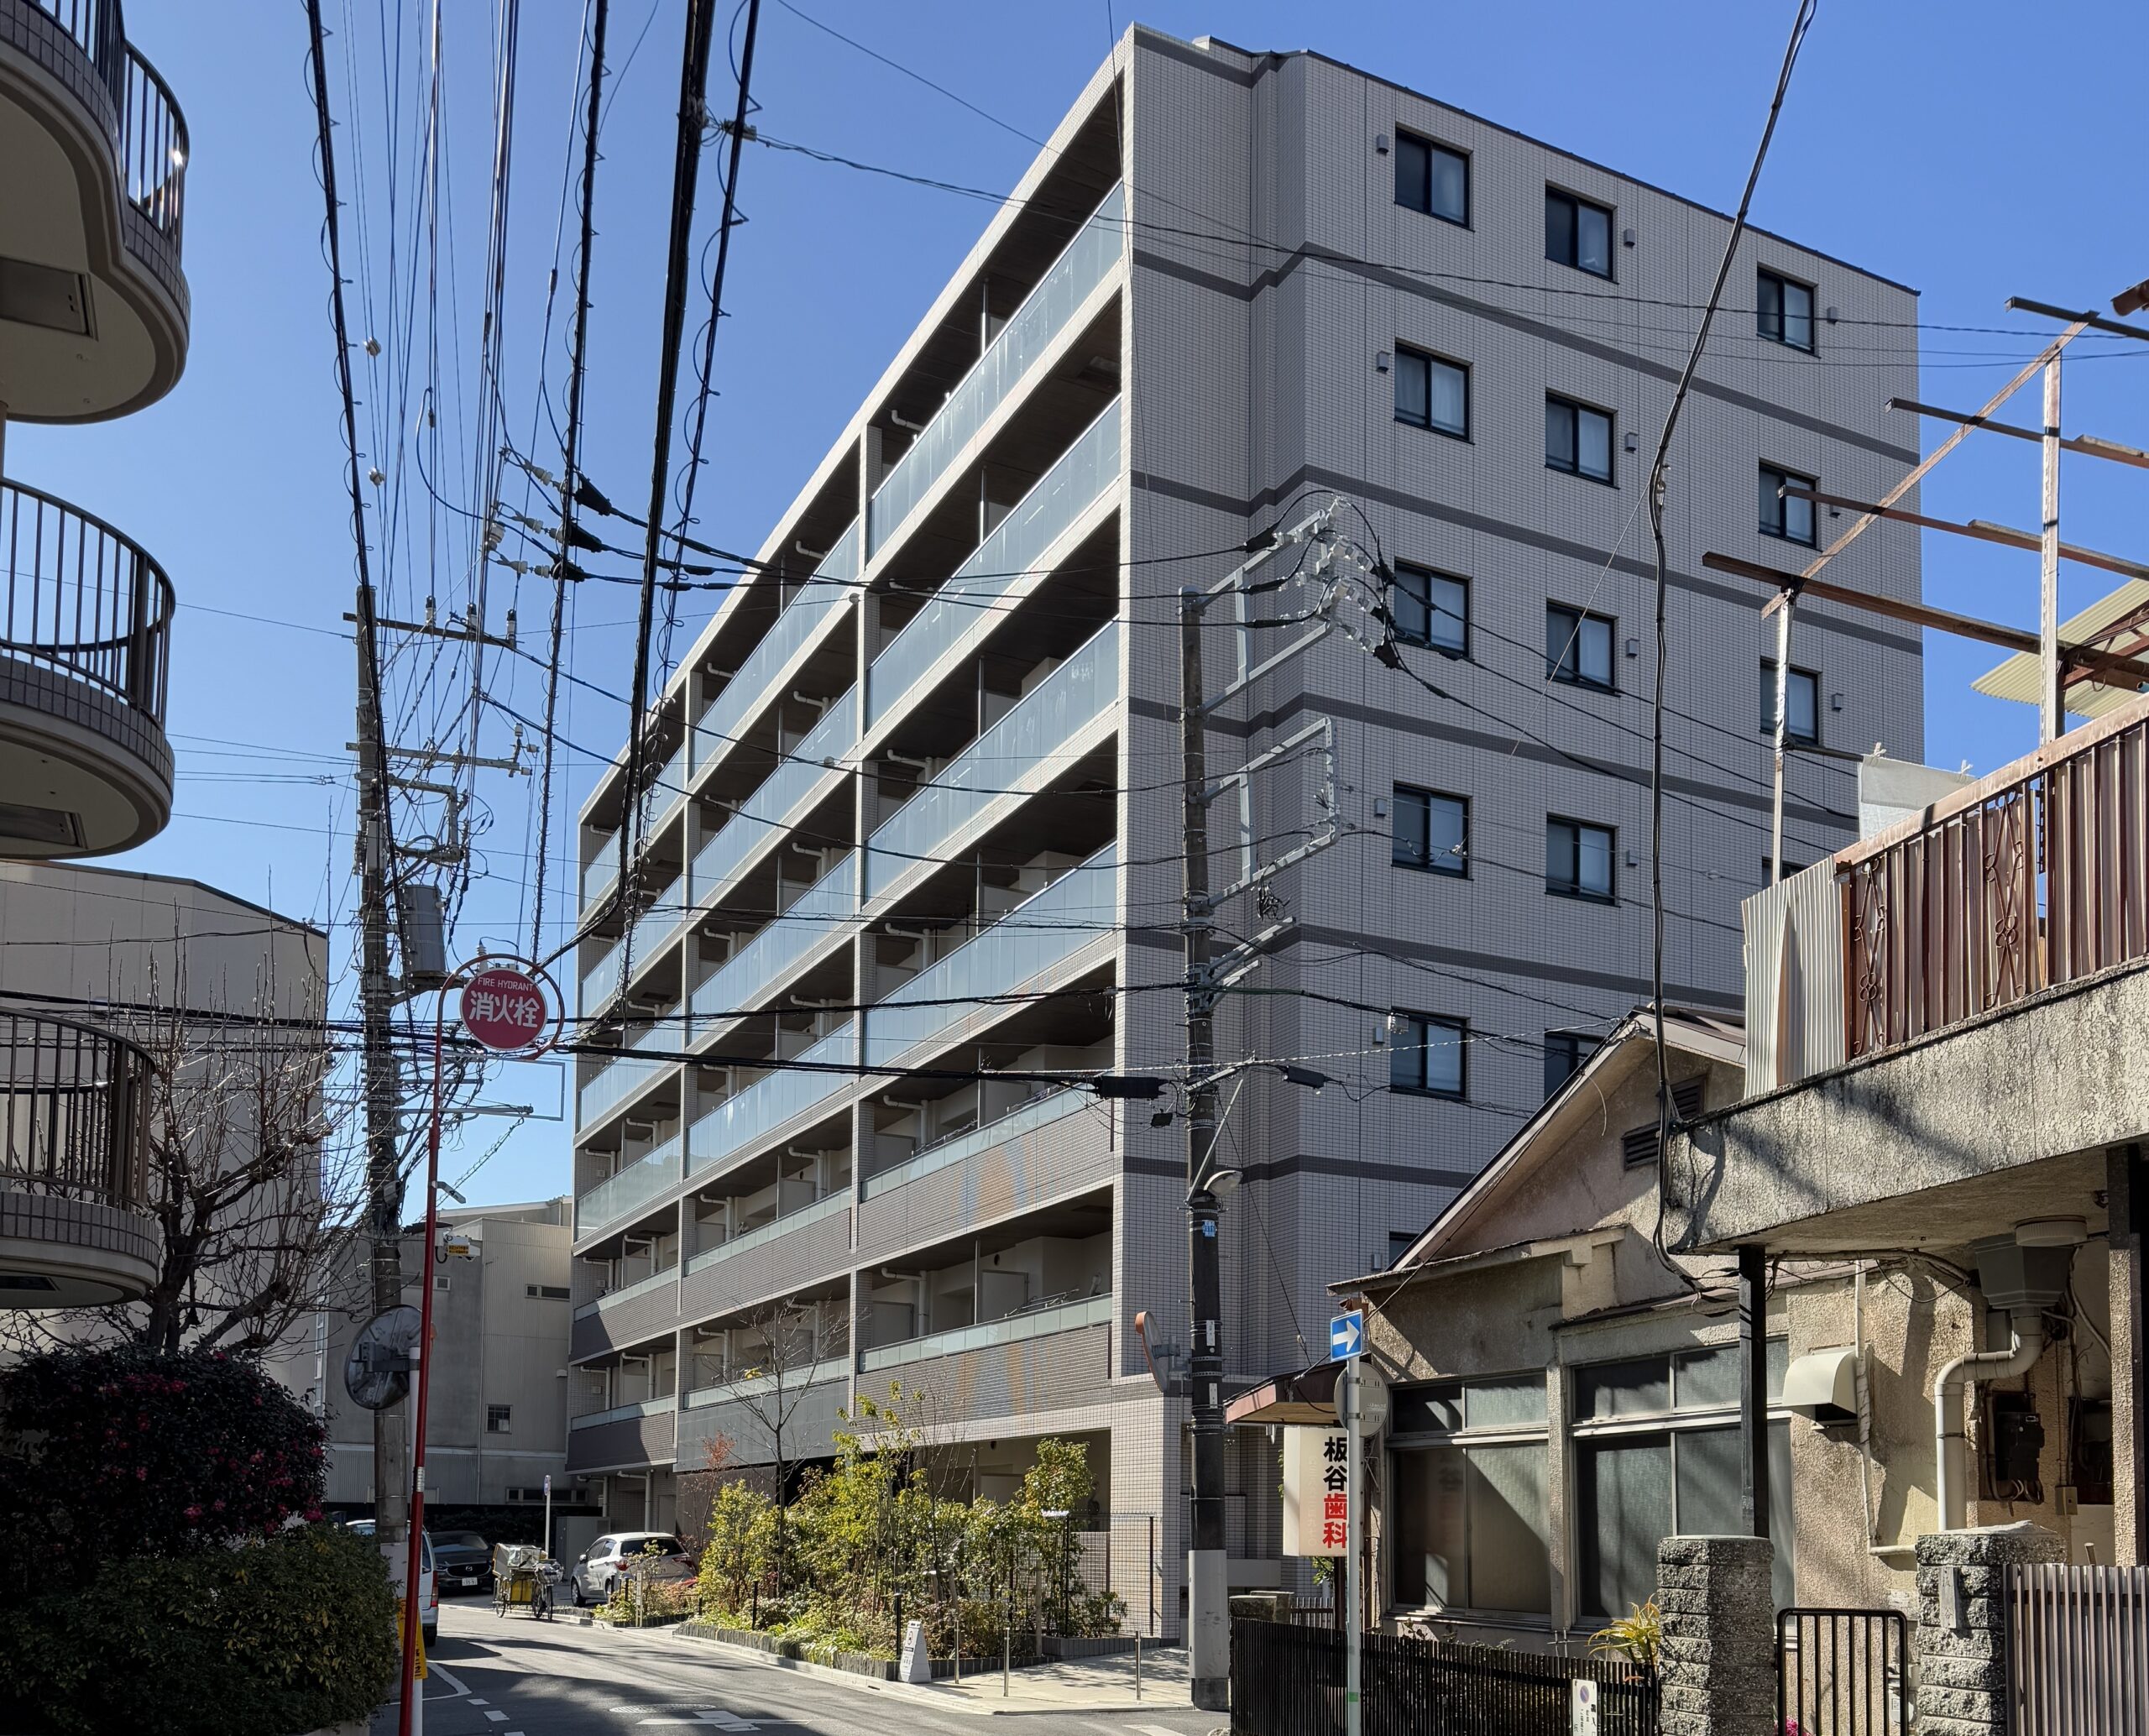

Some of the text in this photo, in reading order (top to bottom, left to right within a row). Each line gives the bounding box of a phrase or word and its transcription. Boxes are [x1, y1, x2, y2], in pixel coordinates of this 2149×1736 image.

[478, 977, 534, 991] FIRE HYDRANT
[469, 990, 540, 1028] 消火栓
[1323, 1436, 1347, 1549] 板谷歯科
